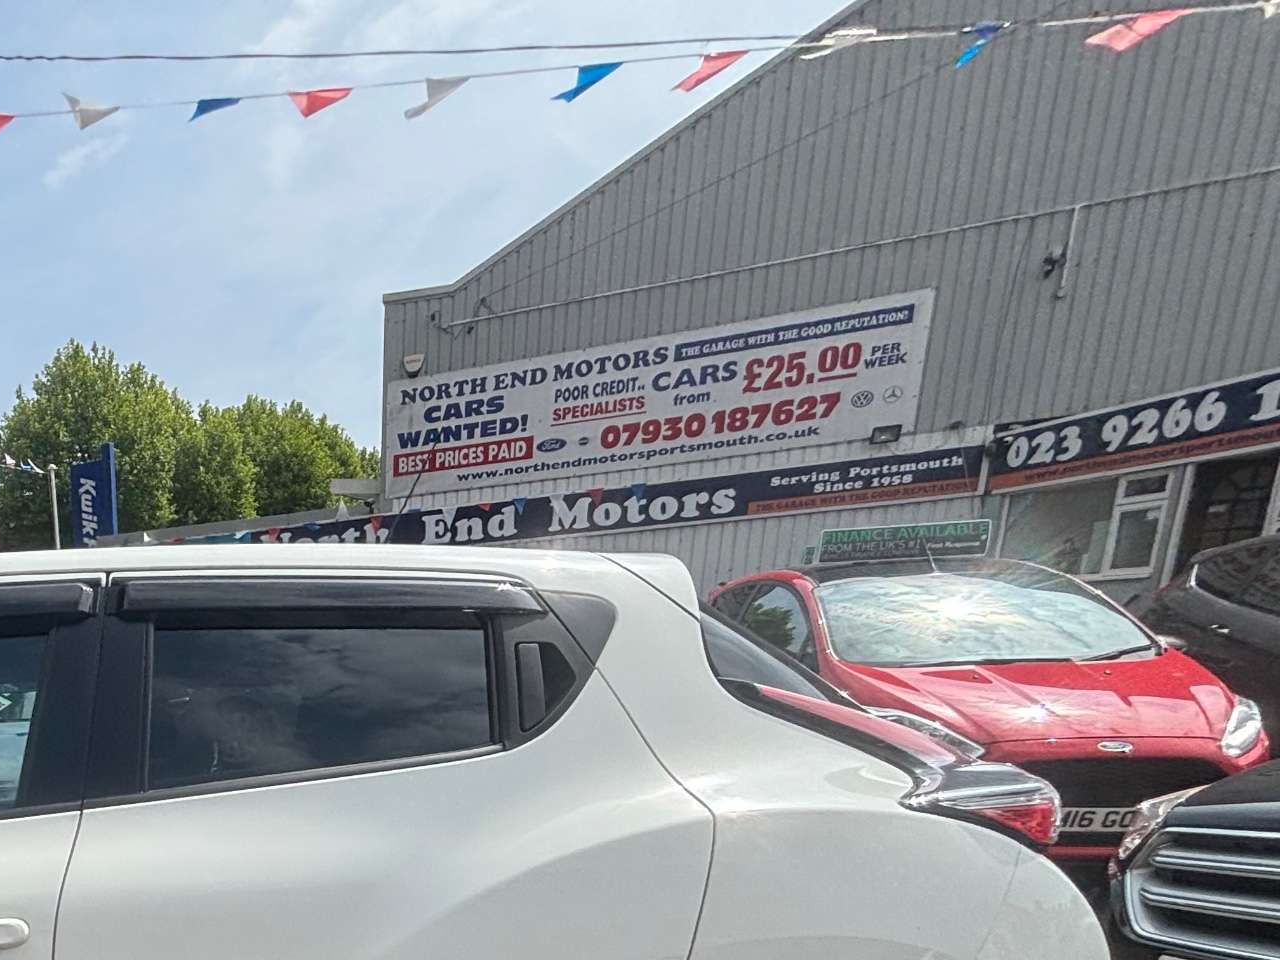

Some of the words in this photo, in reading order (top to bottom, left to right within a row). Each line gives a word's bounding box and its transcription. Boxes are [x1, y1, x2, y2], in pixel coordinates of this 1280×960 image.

[681, 347, 700, 358] THE
[703, 338, 745, 353] GARAGE
[748, 333, 776, 346] WITH
[778, 329, 799, 341] THE
[801, 324, 831, 337] GOOD
[870, 342, 902, 357] PER
[401, 377, 488, 405] NORTH
[493, 367, 548, 391] END
[552, 346, 669, 381] MOTORS
[652, 361, 738, 392] CARS
[742, 342, 862, 394] £25.00
[863, 352, 907, 370] WEEK
[424, 395, 504, 423] CARS
[552, 396, 645, 421] SPECIALISTS
[554, 384, 588, 403] POOR
[673, 391, 711, 406] from
[397, 415, 528, 449] WANTED!
[600, 412, 706, 449] 07930
[711, 392, 841, 434] 187627
[1006, 425, 1082, 468] 023
[1101, 391, 1227, 453] 9266
[398, 454, 431, 473] BEST
[435, 448, 484, 468] PRICES
[488, 440, 527, 461] PAID
[457, 425, 820, 482] www.northendmotorsportsmouth.co.uk
[770, 470, 841, 487] Serving
[849, 456, 964, 478] Portsmouth
[813, 479, 864, 493] Since
[871, 473, 913, 487] 1958
[422, 505, 518, 544] End
[548, 488, 737, 532] Motors
[822, 543, 853, 553] FROM
[856, 541, 876, 551] THE
[823, 529, 894, 542] FINANCE
[899, 523, 988, 539] AVAILABLE
